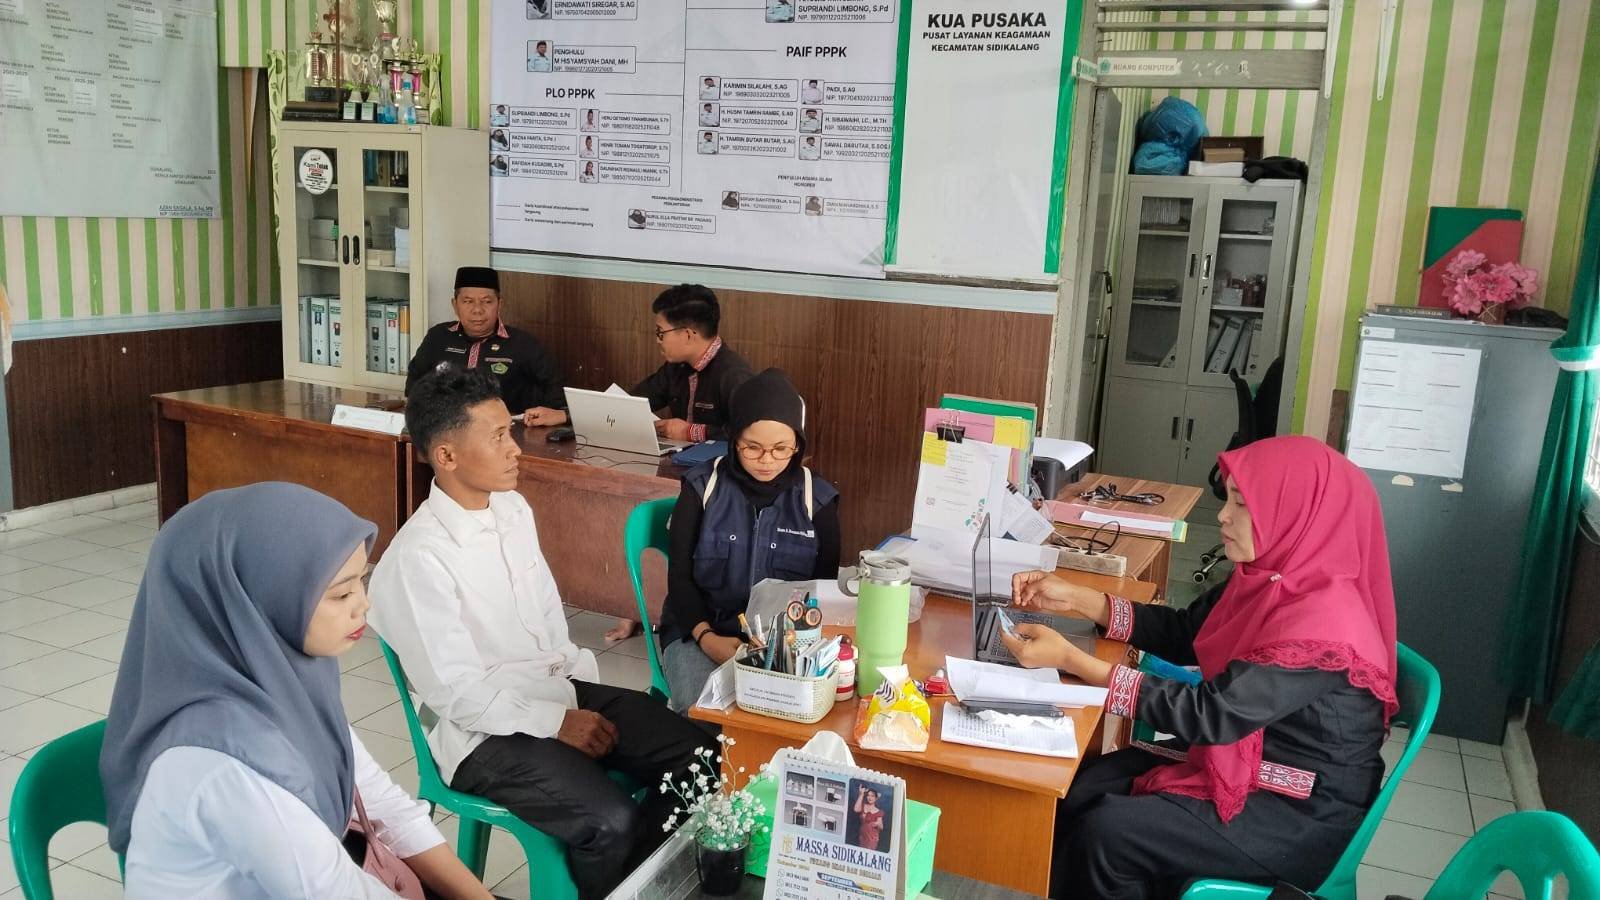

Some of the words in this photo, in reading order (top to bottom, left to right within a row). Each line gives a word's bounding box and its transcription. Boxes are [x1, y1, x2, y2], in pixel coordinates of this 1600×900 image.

[927, 13, 965, 28] KUA
[971, 12, 1047, 28] PUSAKA
[952, 31, 993, 39] LAYANAN
[994, 30, 1051, 39] KEAGAMAAN
[786, 46, 812, 58] PAIF
[815, 46, 847, 58] PPPK
[986, 43, 1040, 51] SIDIKALANG
[545, 88, 566, 98] PLO
[568, 88, 596, 99] PPPK
[606, 414, 616, 428] hp
[795, 836, 831, 859] MASSA
[831, 844, 892, 873] SIDIKALANG
